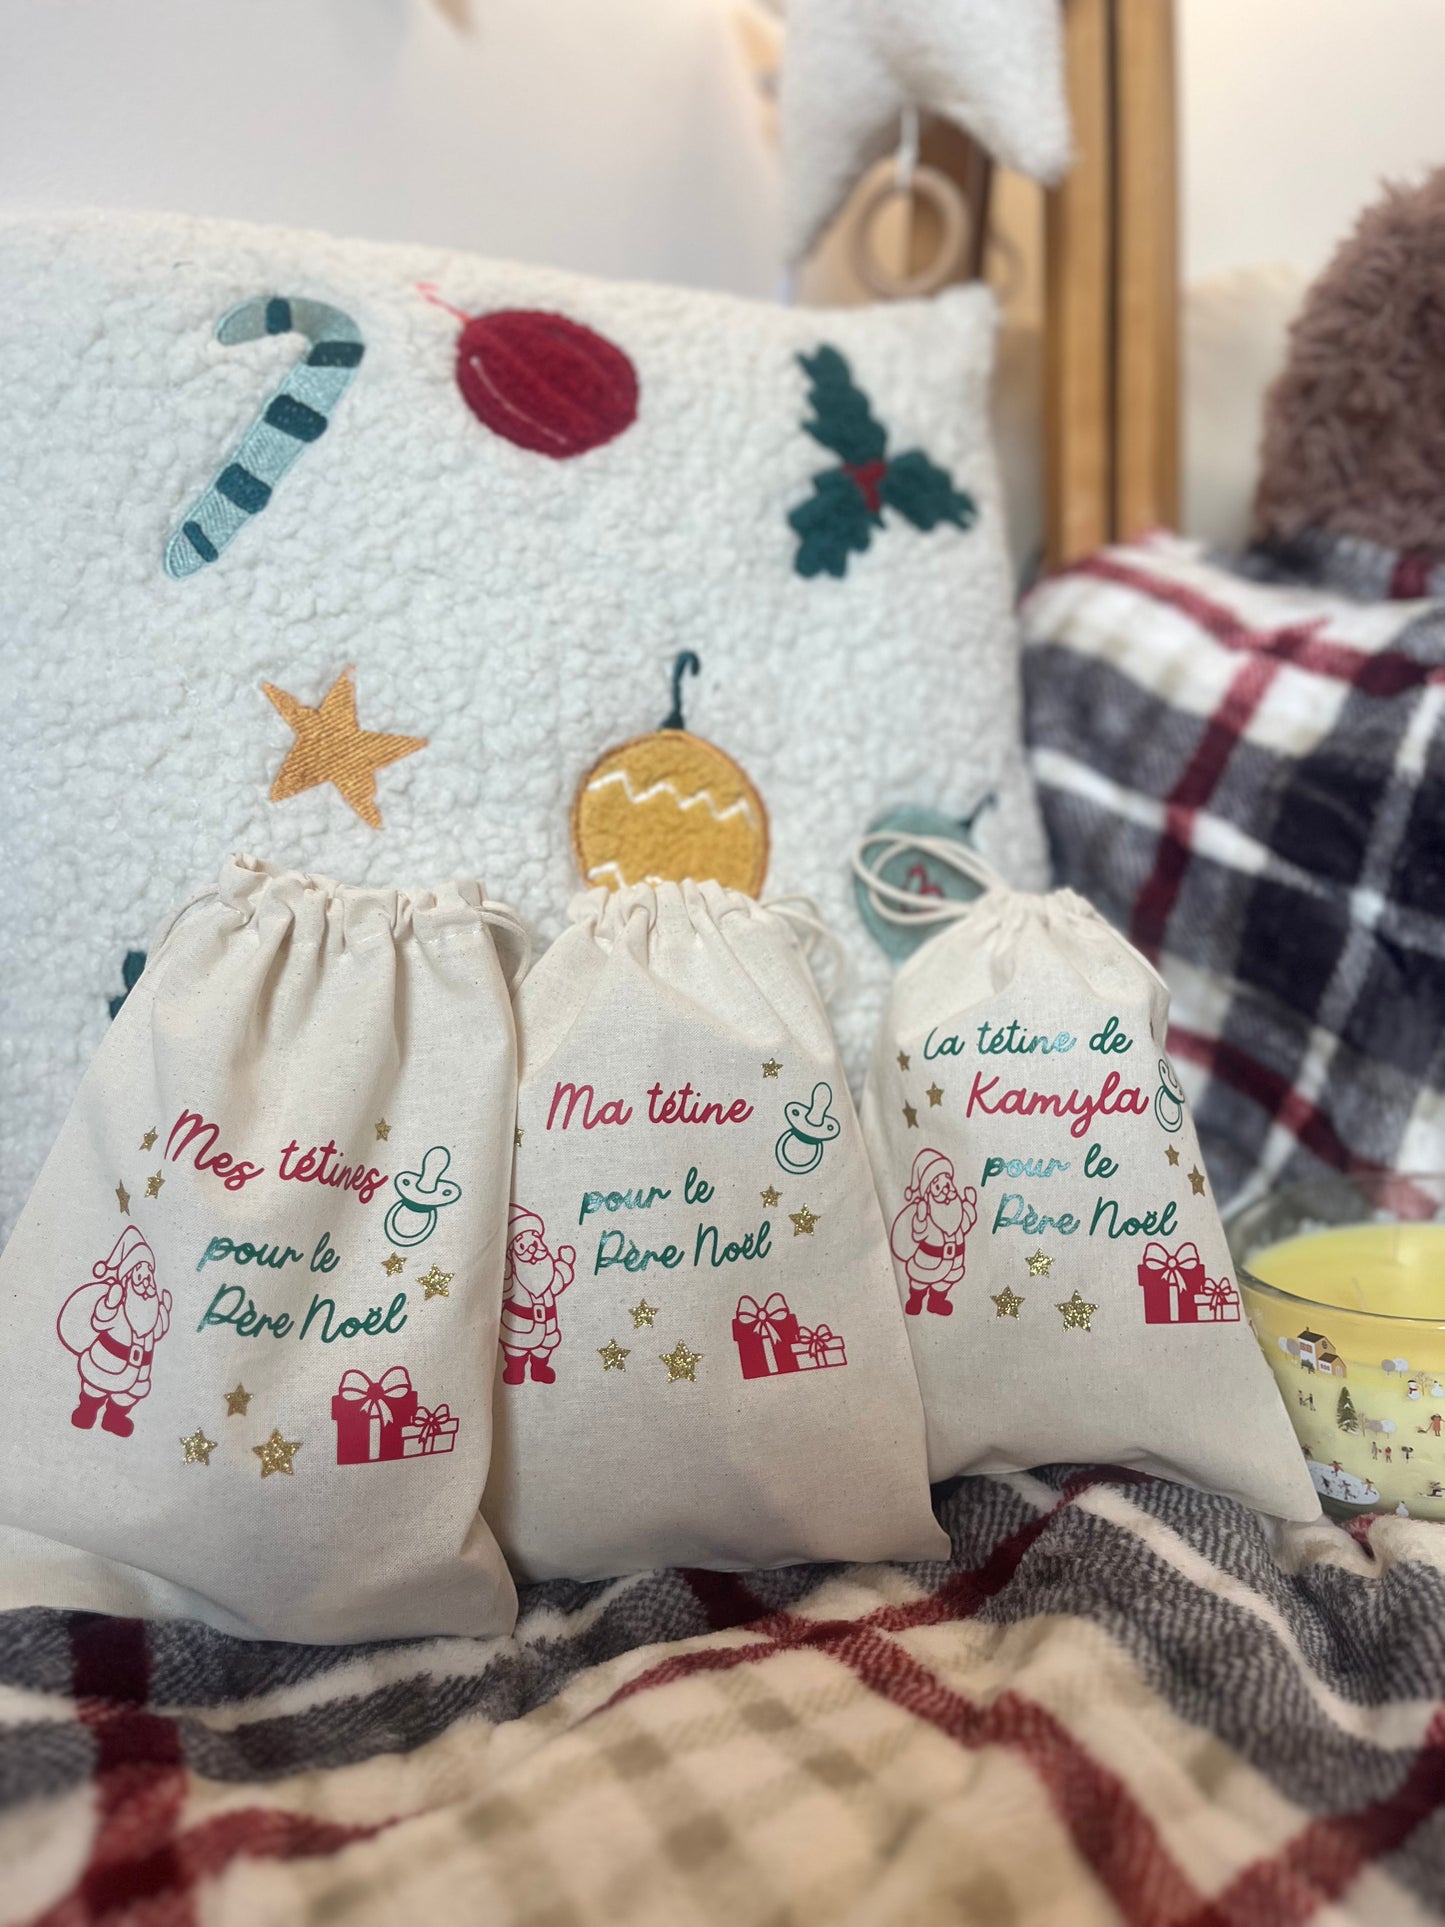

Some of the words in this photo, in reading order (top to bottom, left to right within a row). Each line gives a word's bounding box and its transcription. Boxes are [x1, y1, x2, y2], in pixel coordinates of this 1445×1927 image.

[976, 1019, 1078, 1056] tétine
[1089, 1016, 1134, 1055] de
[546, 1082, 633, 1131] Ma
[647, 1082, 754, 1125] tétine
[966, 1071, 1150, 1138] Kamyla
[164, 1109, 264, 1191] Mes
[279, 1140, 388, 1204] tétines
[980, 1157, 1072, 1188] pour
[1083, 1143, 1120, 1179] le
[578, 1187, 672, 1226] pour
[684, 1166, 715, 1205] le
[991, 1193, 1081, 1236] Père
[1089, 1196, 1178, 1239] Noël
[196, 1236, 303, 1273] pour
[310, 1232, 340, 1273] le
[594, 1230, 685, 1276] Père
[694, 1220, 772, 1267] Noël
[196, 1283, 294, 1338] Père
[299, 1292, 408, 1344] Noël
